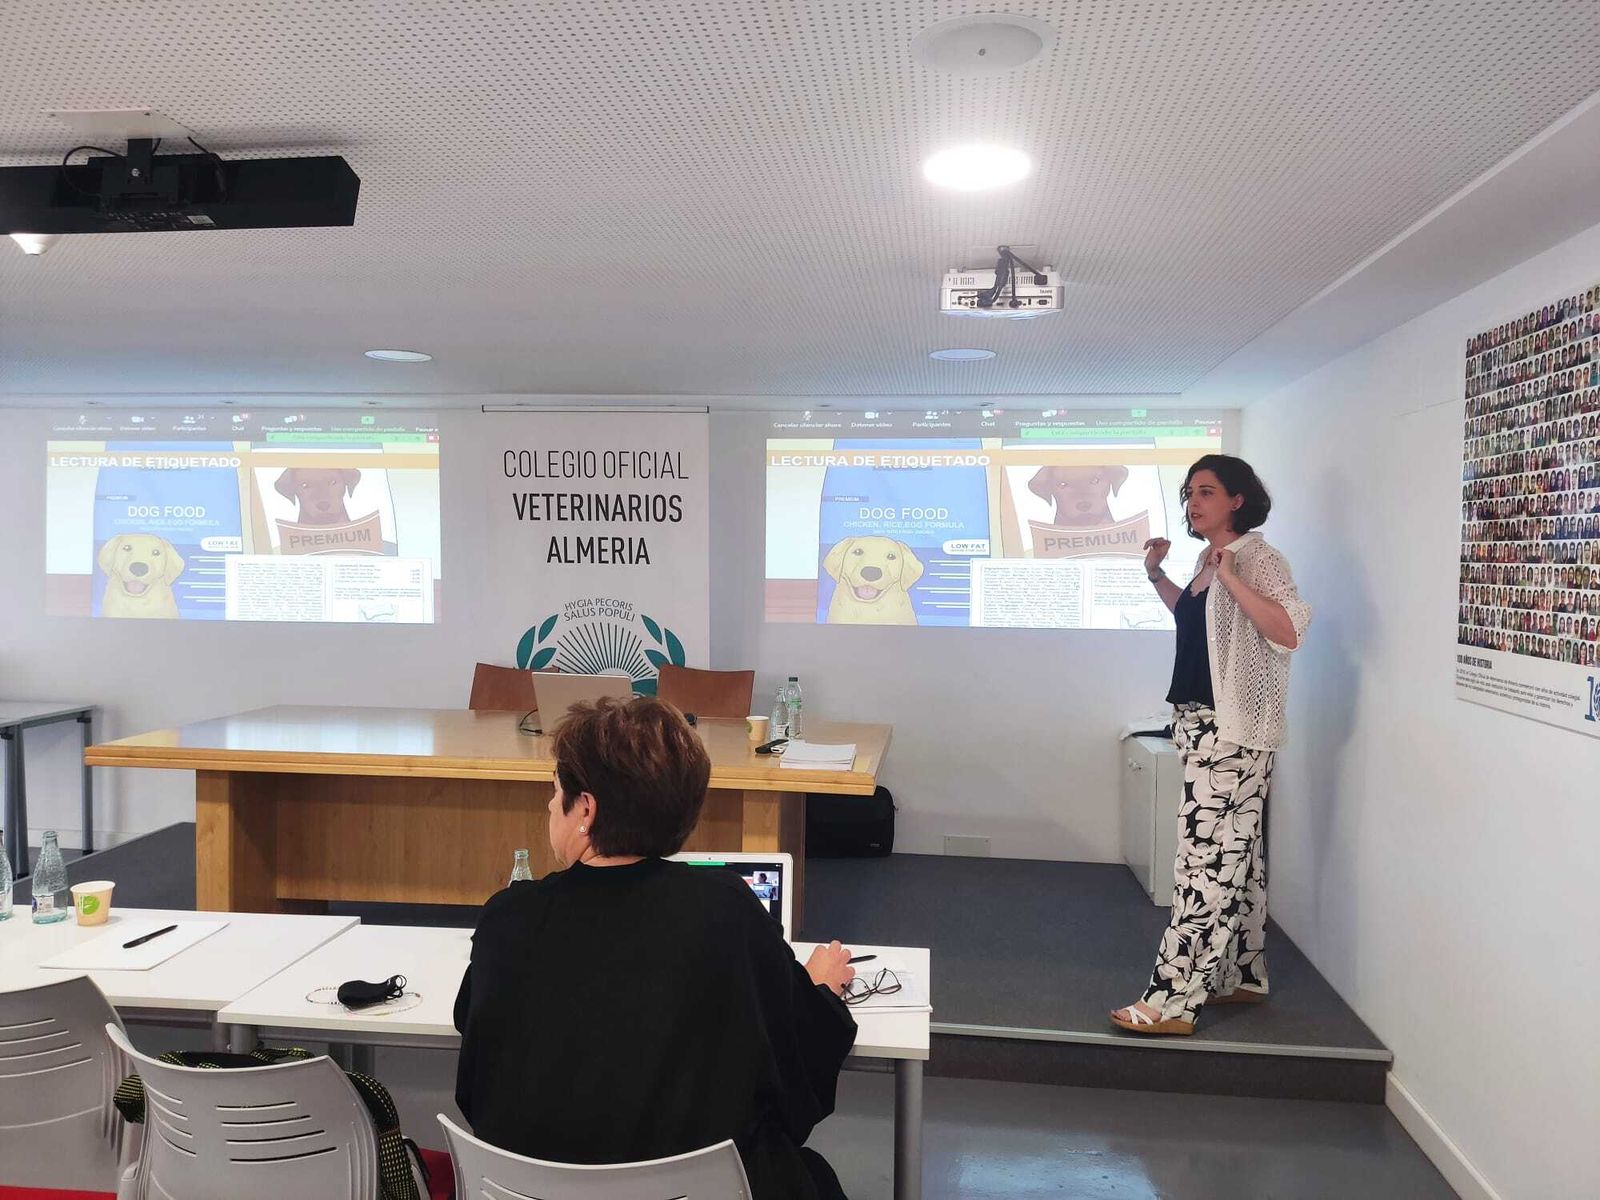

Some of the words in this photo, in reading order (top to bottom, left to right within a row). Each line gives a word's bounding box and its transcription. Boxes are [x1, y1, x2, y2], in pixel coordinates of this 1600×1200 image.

[51, 457, 118, 468] LECTURA
[122, 457, 142, 468] DE
[145, 457, 241, 468] ETIQUETADO
[503, 450, 597, 479] COLEGIO
[603, 451, 689, 480] OFICIAL
[771, 455, 849, 466] LECTURA
[853, 455, 876, 466] DE
[880, 455, 991, 467] ETIQUETADO
[127, 506, 160, 518] DOG
[164, 506, 206, 518] FOOD
[512, 493, 683, 523] VETERINARIOS
[859, 507, 896, 519] DOG
[901, 507, 949, 519] FOOD
[925, 520, 965, 529] FORMULA
[289, 528, 372, 549] PREMIUM
[1043, 529, 1138, 552] PREMIUM
[546, 536, 651, 565] ALMERIA
[564, 599, 593, 611] HYGIA
[595, 598, 633, 611] PECORIS
[563, 607, 596, 621] SALUS
[598, 607, 635, 622] POPULI
